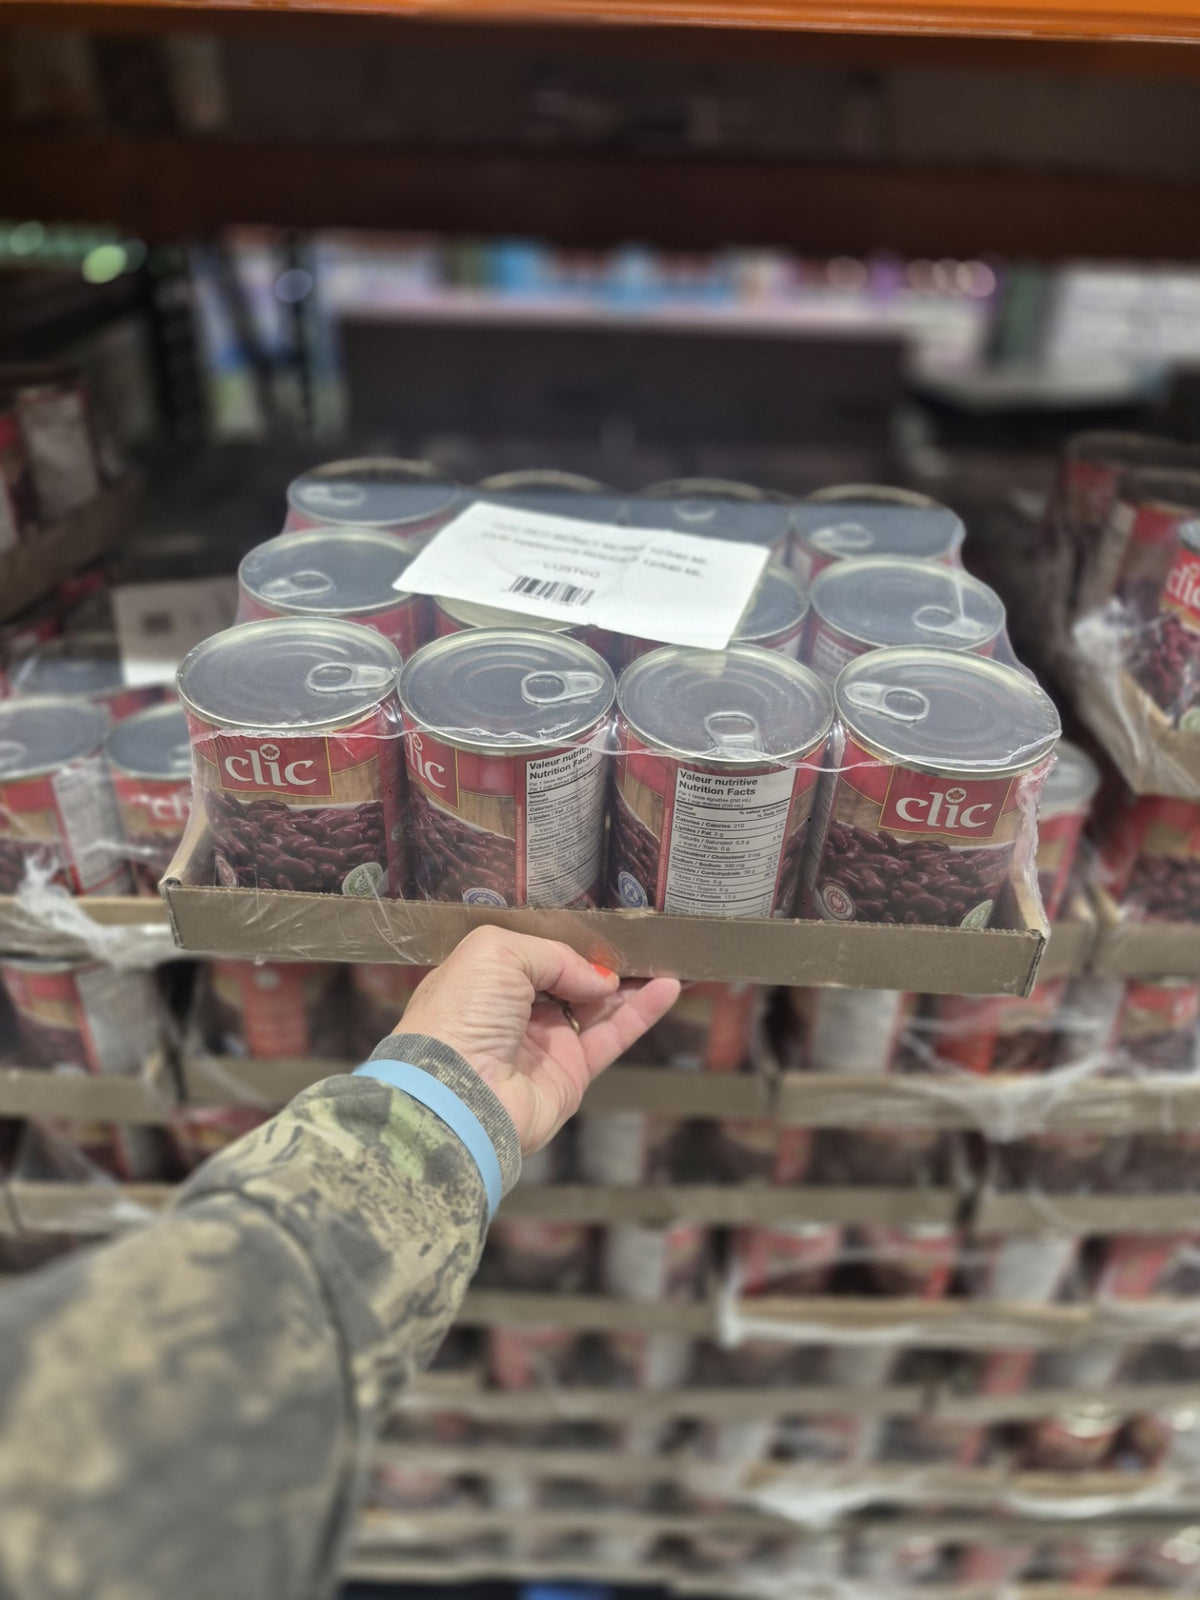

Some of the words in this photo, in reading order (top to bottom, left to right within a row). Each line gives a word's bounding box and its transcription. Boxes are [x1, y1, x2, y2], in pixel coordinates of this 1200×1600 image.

[224, 743, 317, 787] clic
[529, 758, 561, 770] Valeur
[529, 764, 571, 780] Nutrition
[572, 752, 593, 768] Facts
[680, 769, 713, 783] Valeur
[714, 778, 758, 786] nutritive
[679, 780, 724, 796] Nutrition
[727, 787, 756, 796] Facts
[895, 787, 992, 829] clic
[675, 816, 700, 826] Calories
[675, 824, 696, 834] Lipides
